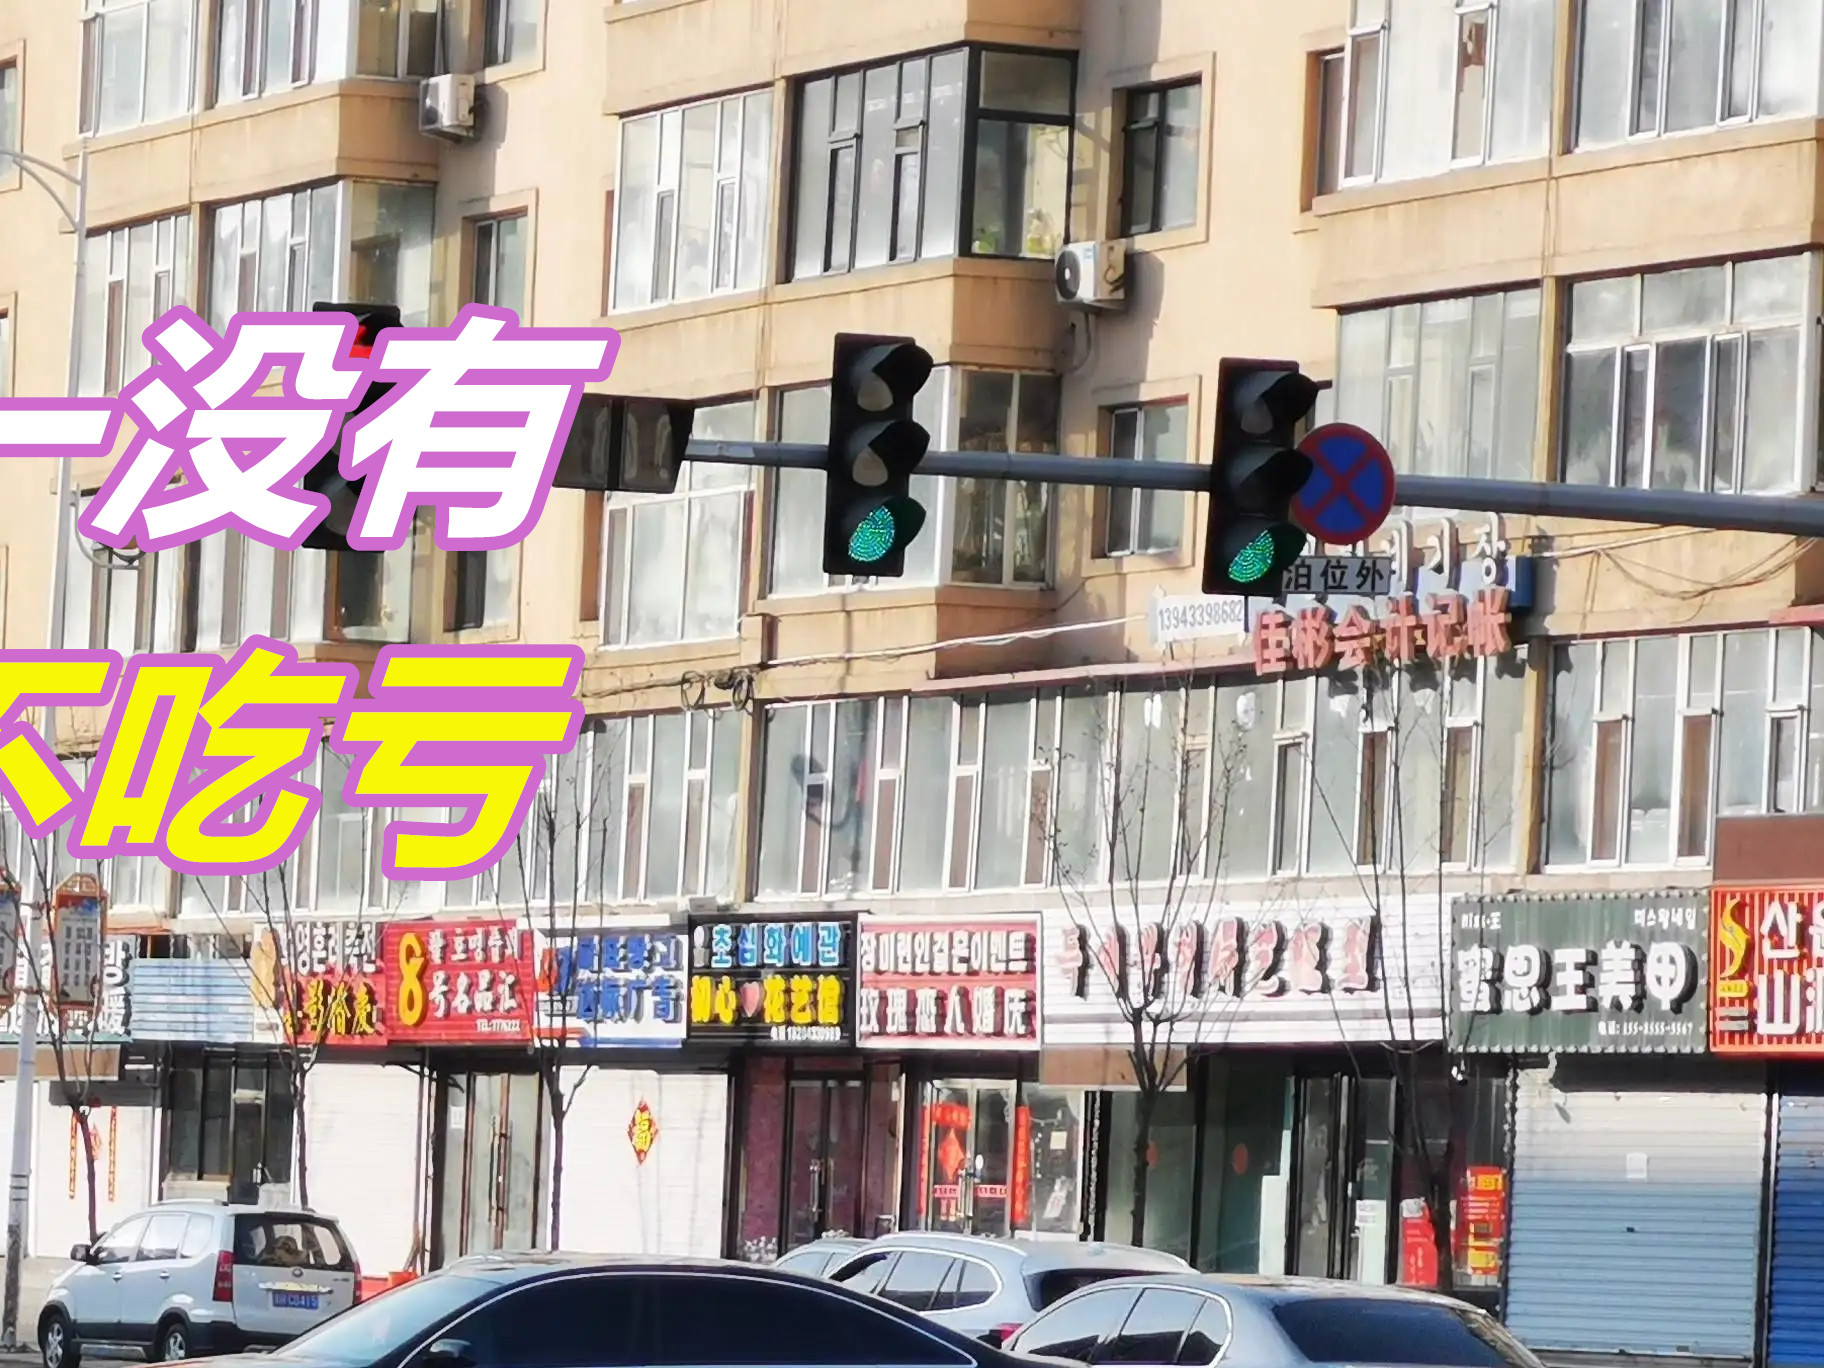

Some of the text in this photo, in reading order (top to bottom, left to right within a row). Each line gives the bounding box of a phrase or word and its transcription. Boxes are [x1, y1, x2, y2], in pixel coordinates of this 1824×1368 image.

[1253, 587, 1512, 676] 佳彬会计记帐
